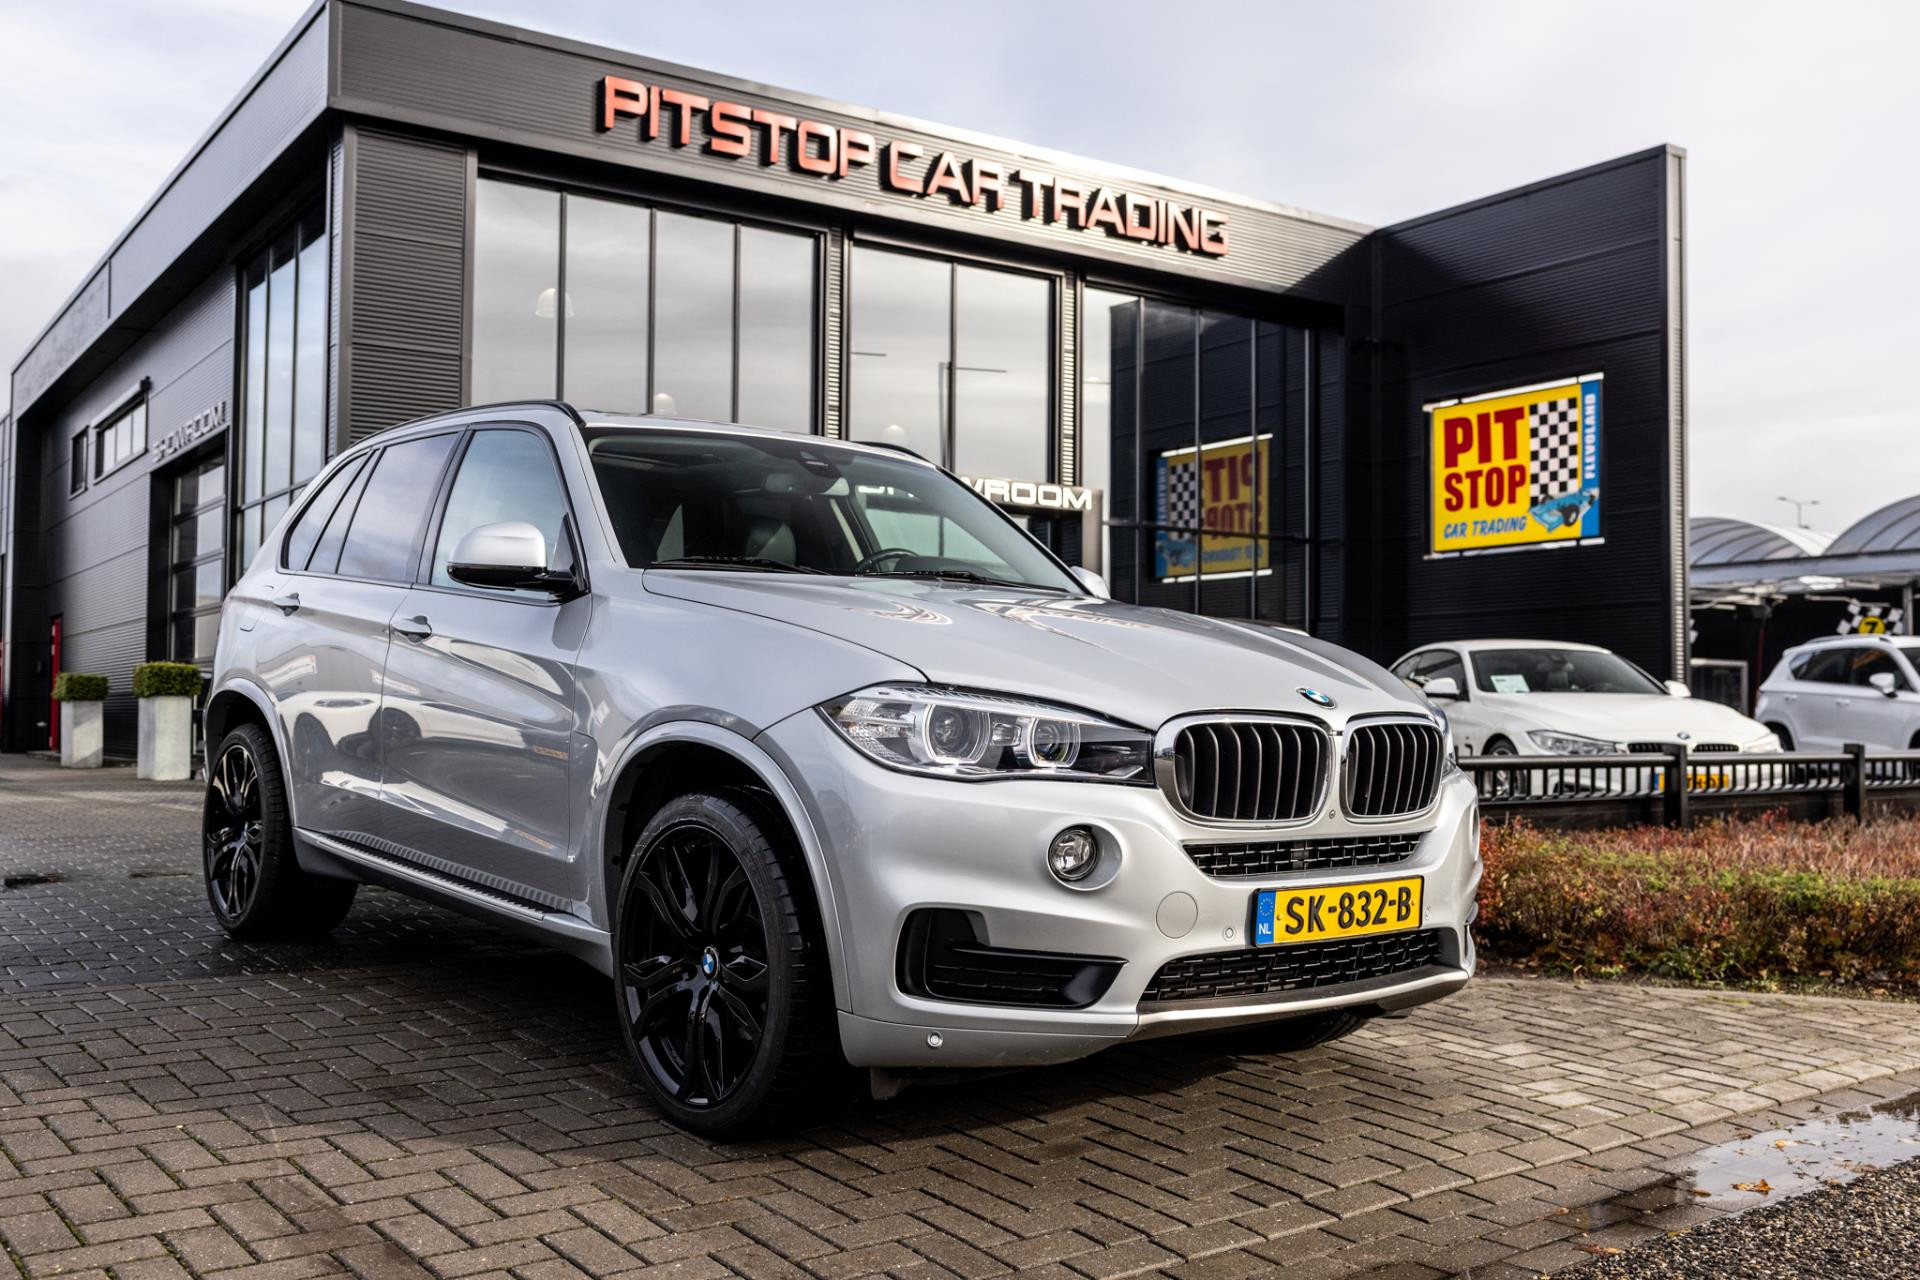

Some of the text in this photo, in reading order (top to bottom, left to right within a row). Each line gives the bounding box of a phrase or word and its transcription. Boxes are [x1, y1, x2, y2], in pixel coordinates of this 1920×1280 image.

[603, 75, 1230, 256] PITSTOP CAR TRADING
[1443, 406, 1525, 469] PIT
[1444, 464, 1527, 512] STOP
[1443, 515, 1528, 539] CAR TRADING
[1258, 922, 1272, 935] NL
[1285, 886, 1412, 935] SK-832-B
